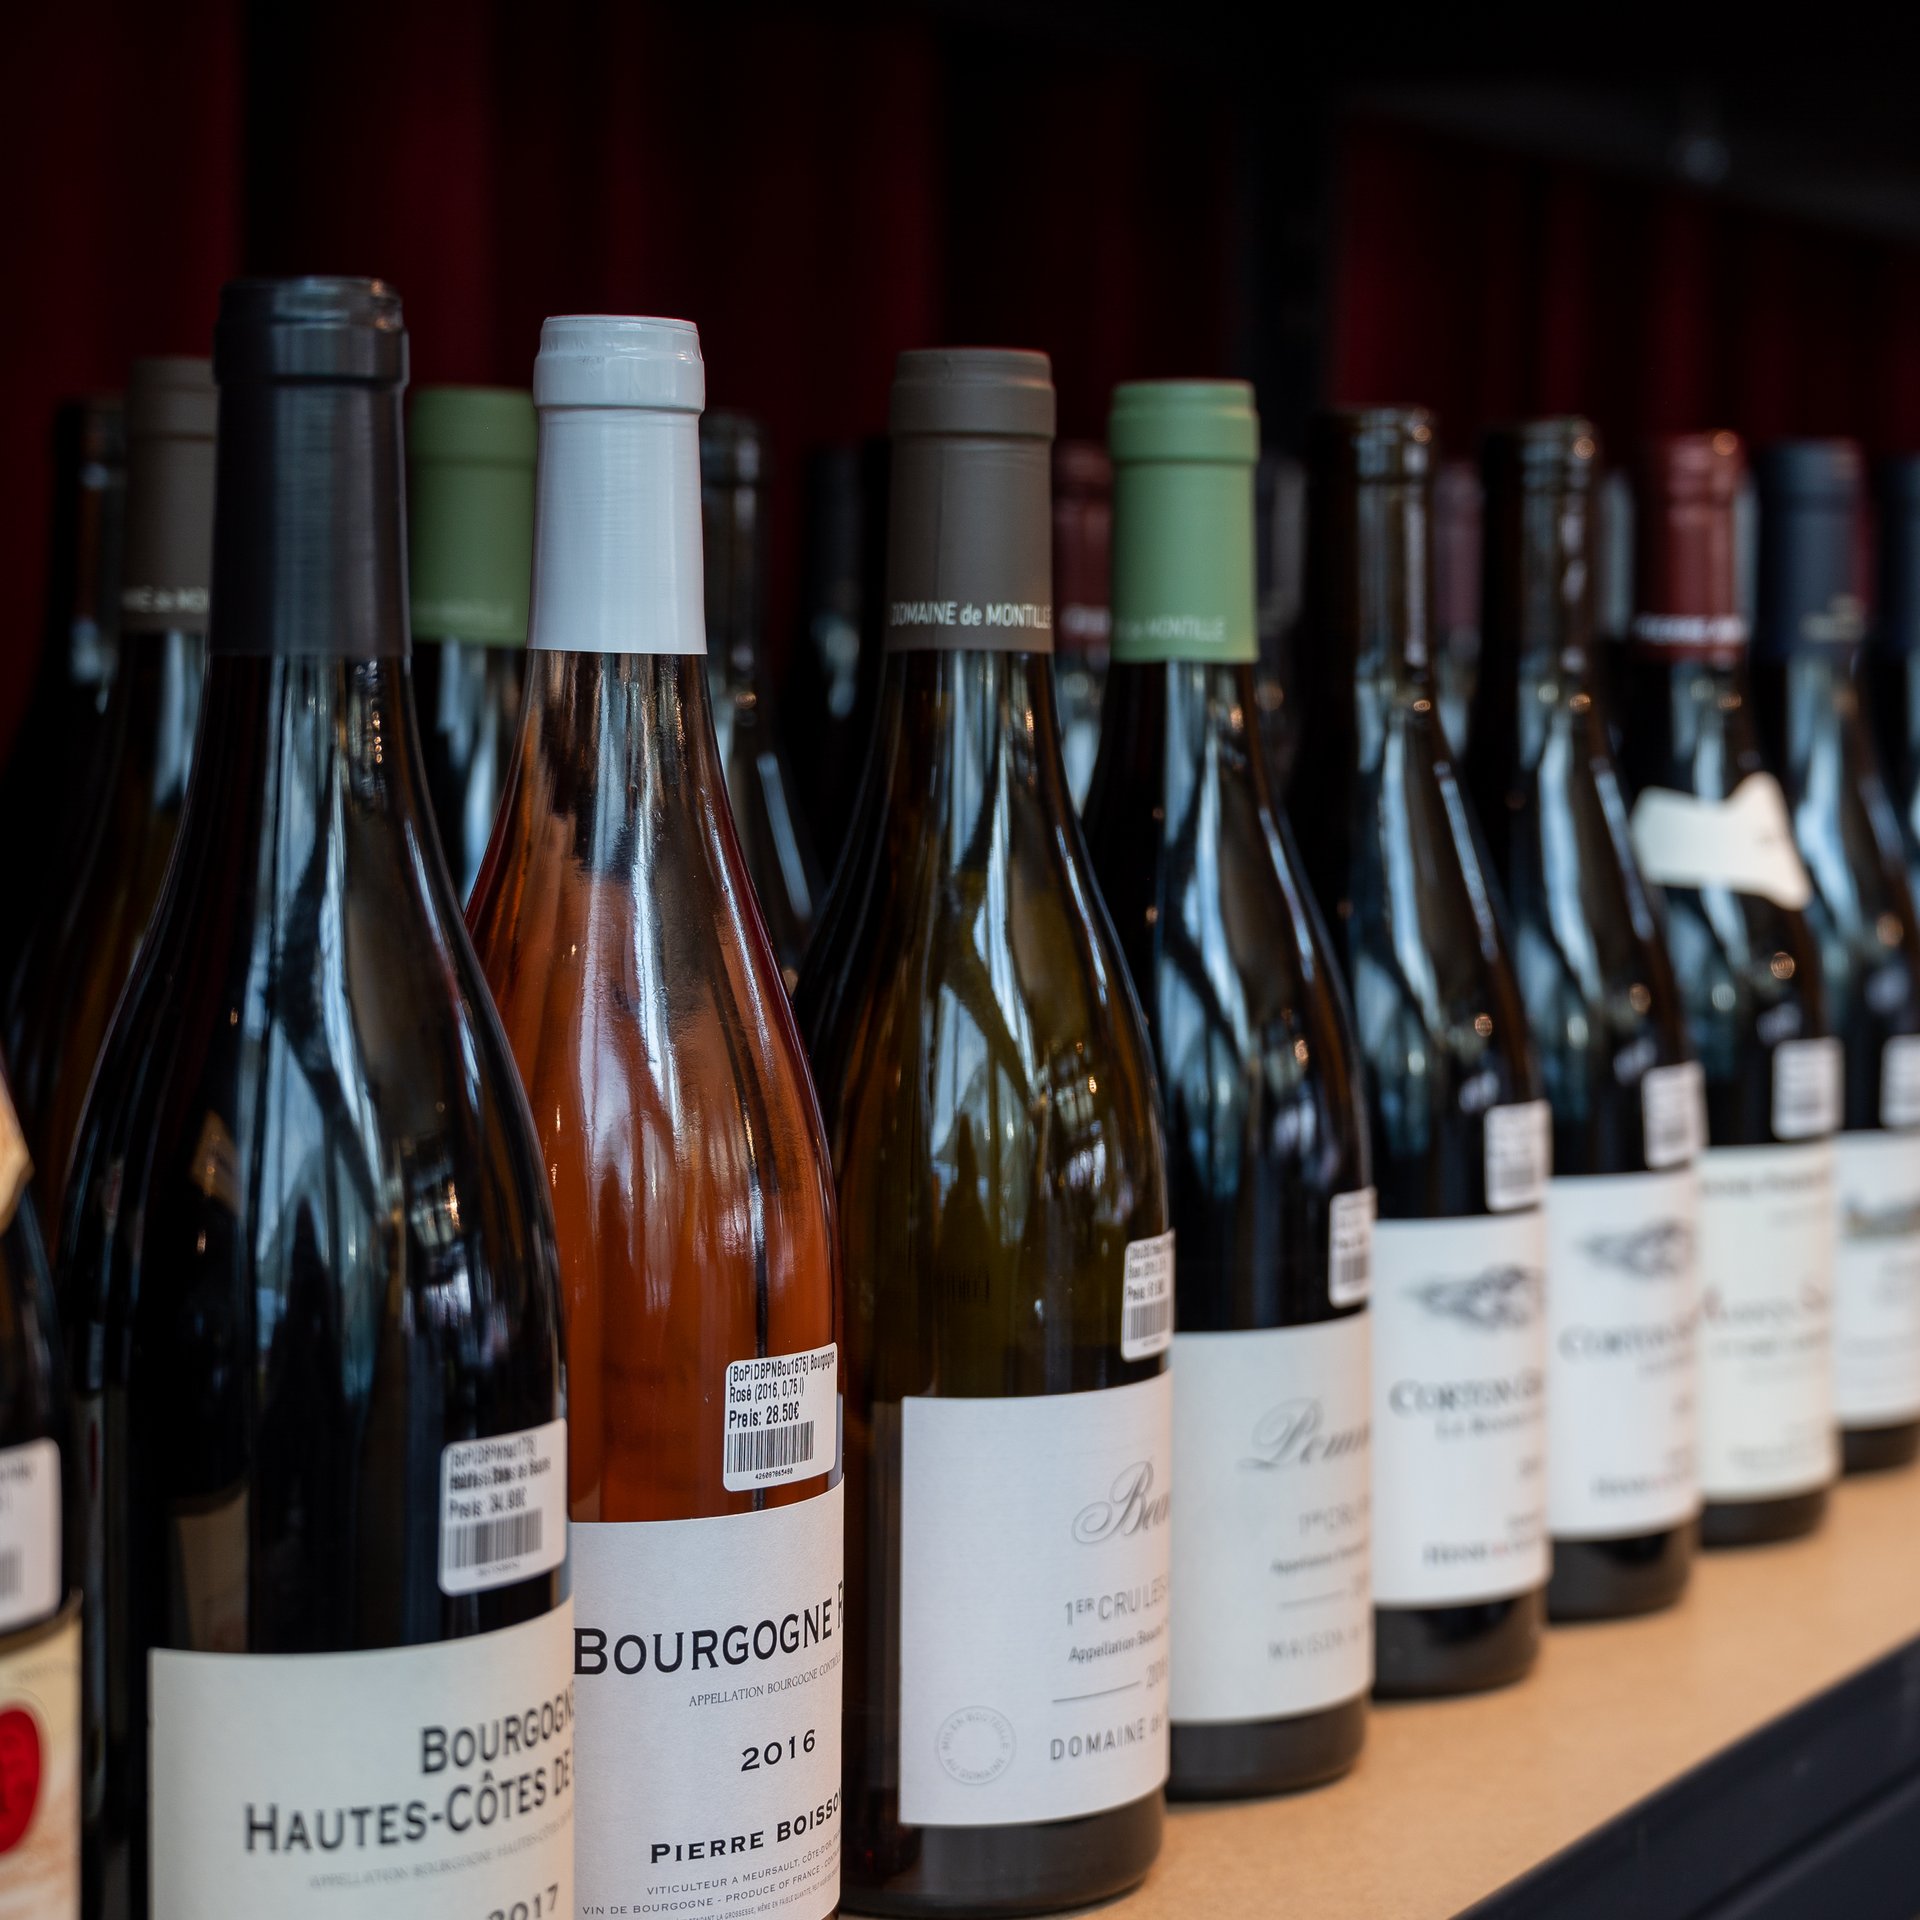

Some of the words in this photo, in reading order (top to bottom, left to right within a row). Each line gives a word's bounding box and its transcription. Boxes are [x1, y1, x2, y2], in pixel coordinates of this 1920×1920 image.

[891, 601, 957, 626] DOMAINE
[960, 603, 982, 627] de
[729, 1384, 752, 1403] Rosé
[755, 1381, 780, 1404] (2016,
[782, 1378, 798, 1398] 0,75
[728, 1408, 762, 1429] Preis:
[766, 1401, 800, 1425] 28.50€
[573, 1597, 832, 1675] BOURGOGNE
[689, 1685, 764, 1707] APPELLATION
[767, 1667, 818, 1695] BOURGOGNE
[740, 1729, 816, 1772] 2016
[1050, 1717, 1145, 1761] DOMAINE
[245, 1766, 547, 1852] HAUTES-CÔTES
[651, 1830, 764, 1864] PIERRE
[583, 1906, 605, 1916] VIN
[610, 1906, 628, 1916] DE
[633, 1897, 714, 1914] BOURGOGNE
[725, 1884, 776, 1903] PRODUCE
[778, 1879, 790, 1890] OF
[792, 1865, 820, 1885] FRANCE
[646, 1878, 728, 1896] VITICULTEUR
[731, 1876, 739, 1885] A
[742, 1858, 800, 1883] MEURSAULT,
